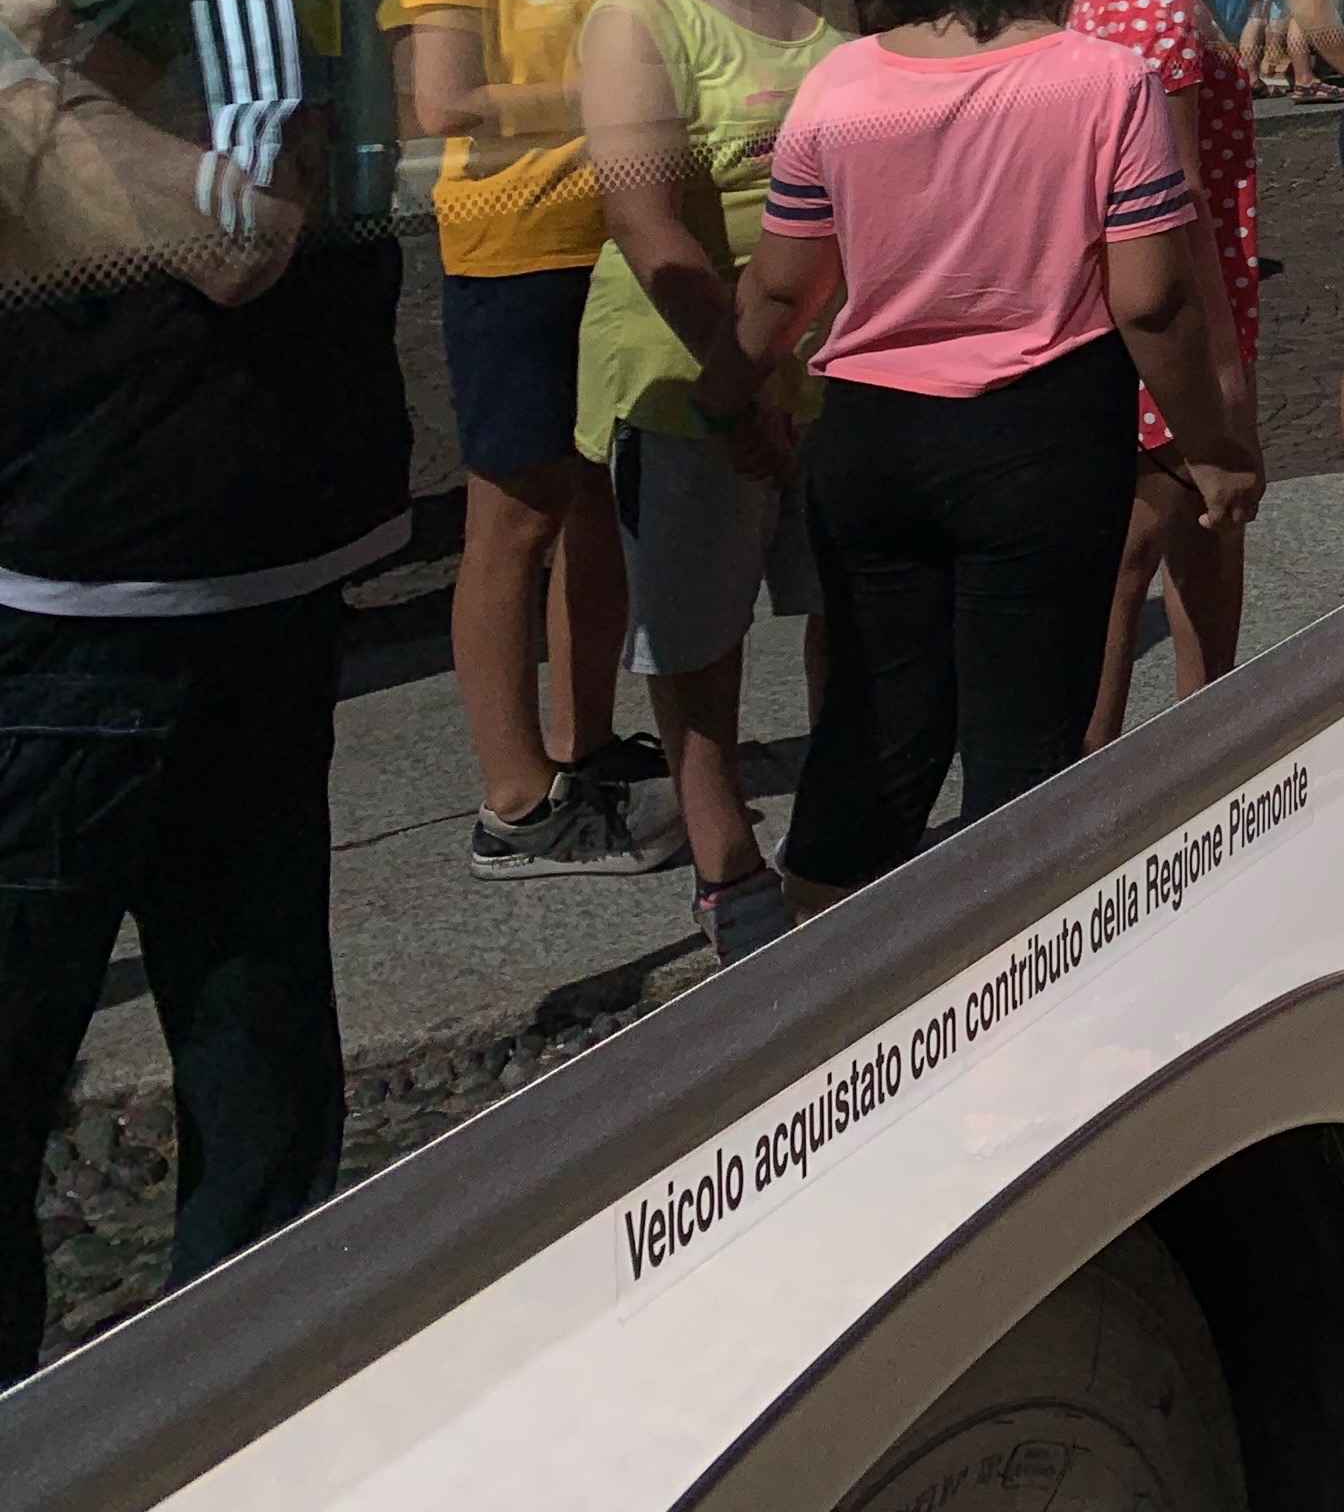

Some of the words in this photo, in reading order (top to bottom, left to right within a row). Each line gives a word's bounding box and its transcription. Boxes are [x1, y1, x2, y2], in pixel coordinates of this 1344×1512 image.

[624, 1147, 744, 1281] Veicolo
[754, 1042, 902, 1192] acquistato
[911, 1006, 957, 1080] con
[966, 918, 1083, 1041] contributo
[1090, 874, 1139, 953] della
[1146, 823, 1223, 912] Regione
[1228, 762, 1308, 857] Piemonte
